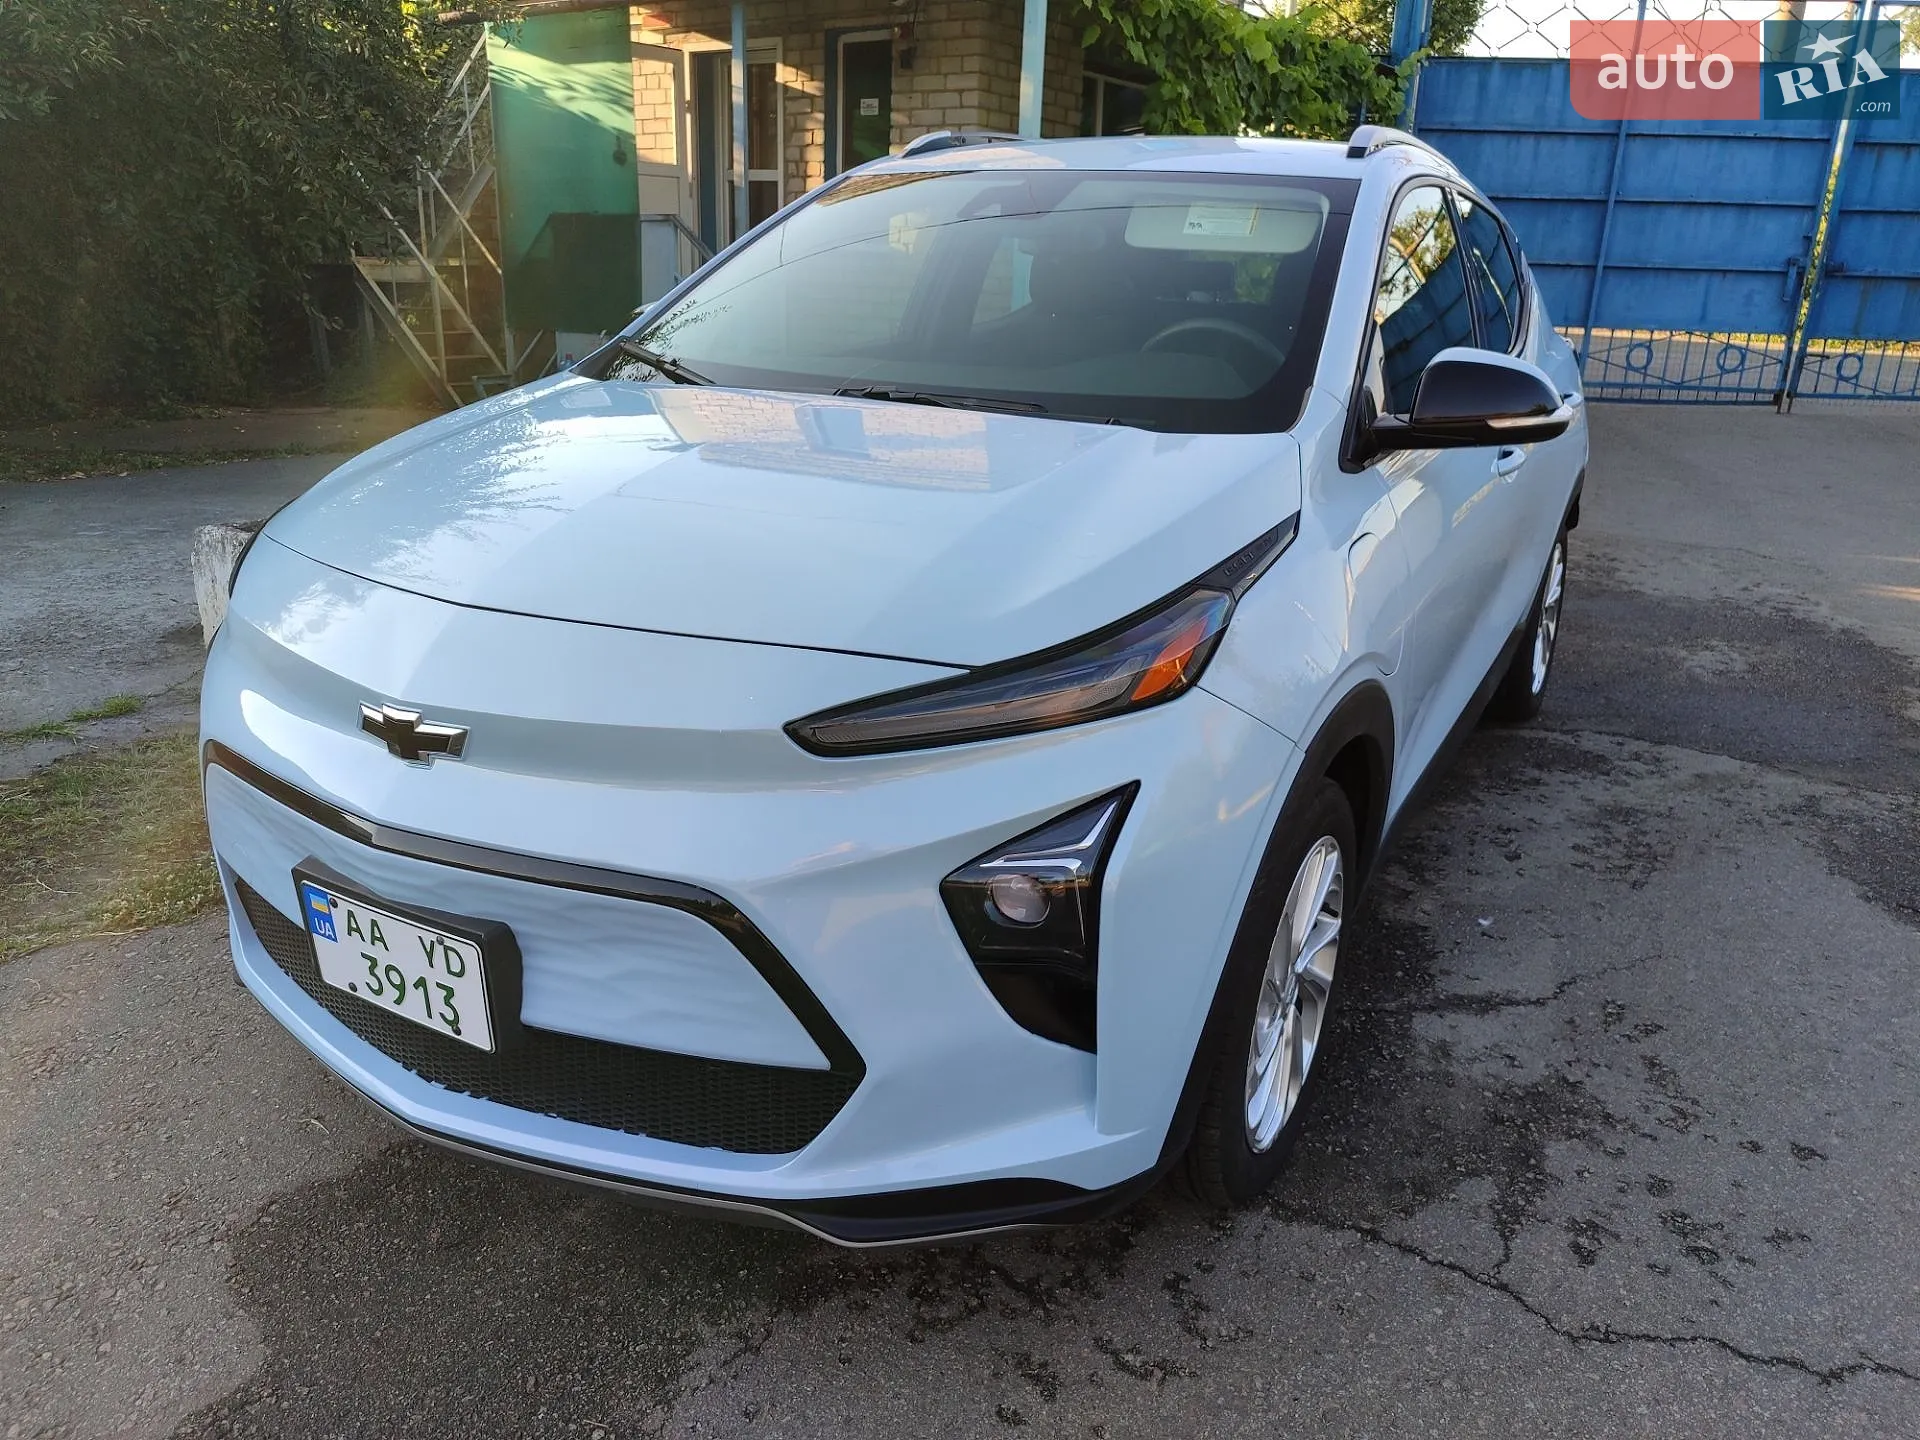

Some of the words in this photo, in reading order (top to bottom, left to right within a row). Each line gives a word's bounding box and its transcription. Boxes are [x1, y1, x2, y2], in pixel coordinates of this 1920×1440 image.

[314, 917, 336, 940] UA
[346, 909, 390, 952] AA
[417, 935, 466, 978] YD
[360, 951, 461, 1028] 3913
